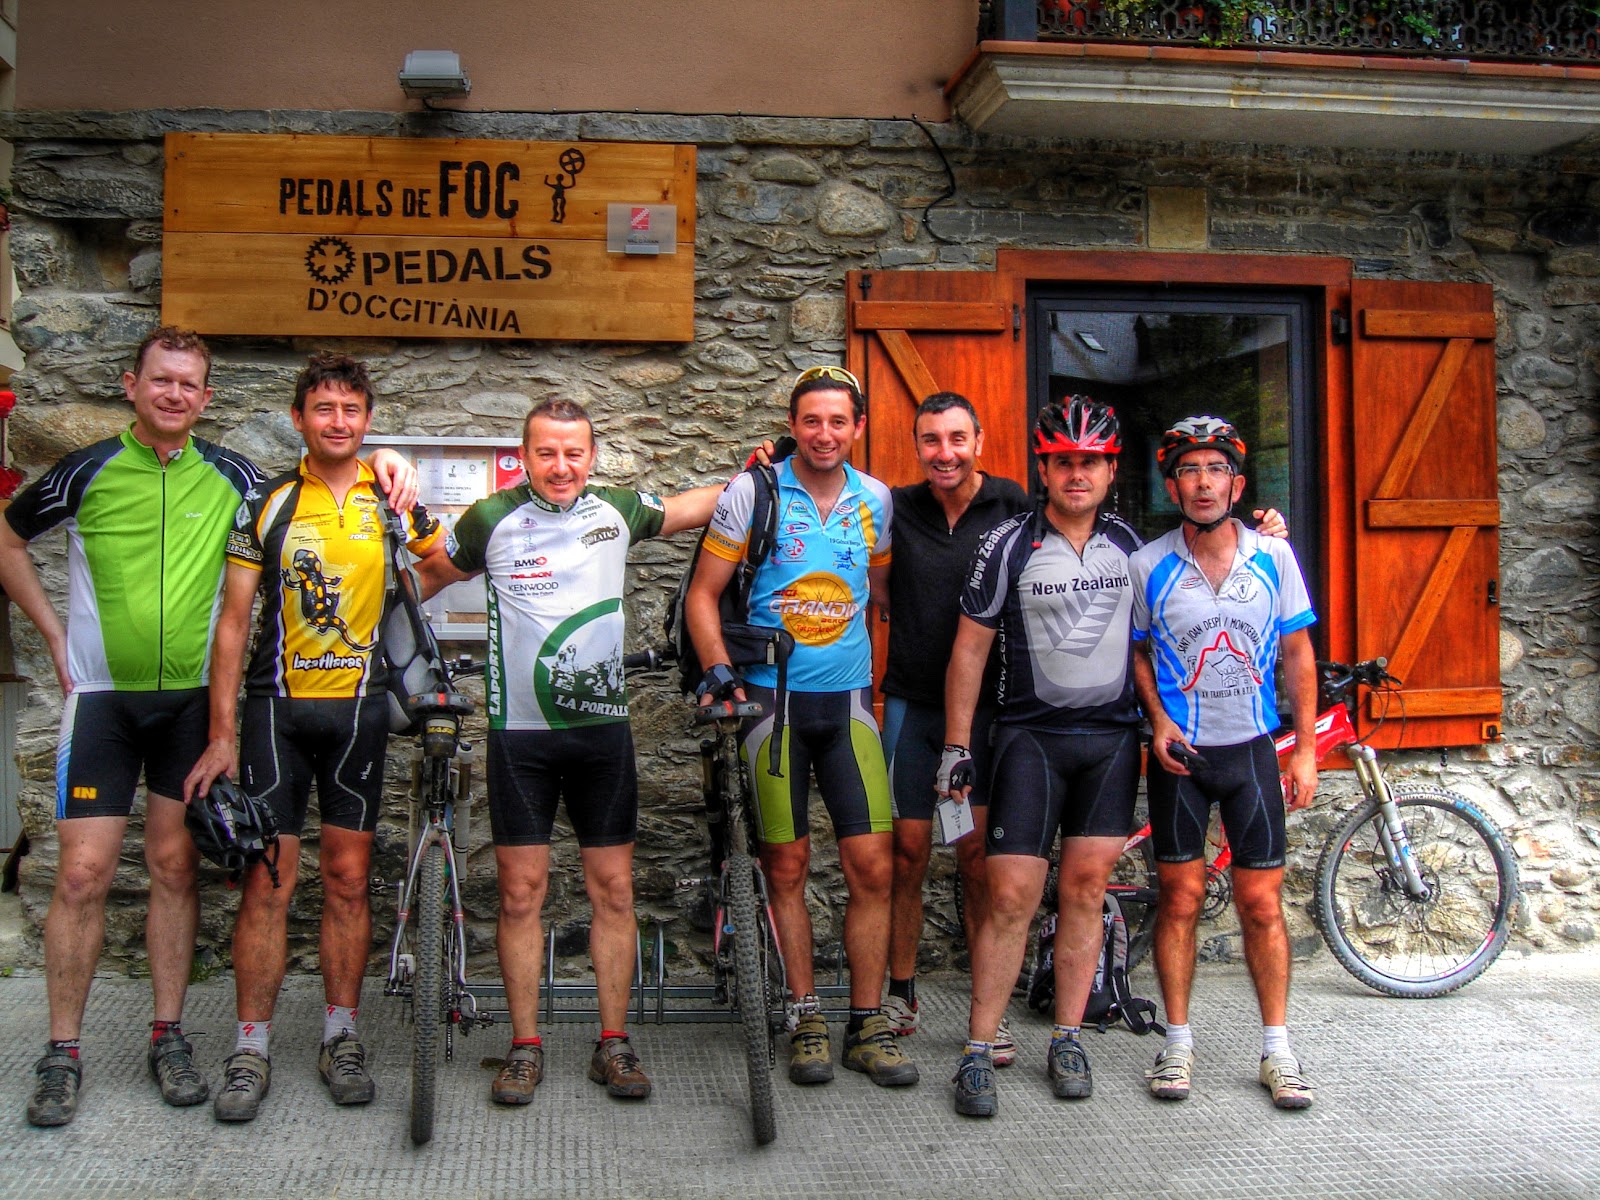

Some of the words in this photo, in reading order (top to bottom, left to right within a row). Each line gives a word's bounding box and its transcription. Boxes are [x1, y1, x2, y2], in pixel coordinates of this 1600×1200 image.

[279, 177, 393, 218] PEDALS
[402, 187, 431, 218] DE
[439, 160, 520, 219] FOC
[363, 244, 552, 286] PEDALS
[307, 287, 521, 334] D'OCCITÀNIA
[969, 559, 987, 590] New
[978, 518, 1021, 559] Zealand
[508, 581, 559, 592] KENWOOD
[1032, 581, 1067, 596] New
[1072, 574, 1130, 592] Zealand
[555, 694, 577, 710] LA
[1401, 793, 1456, 805] HUTCHINSON
